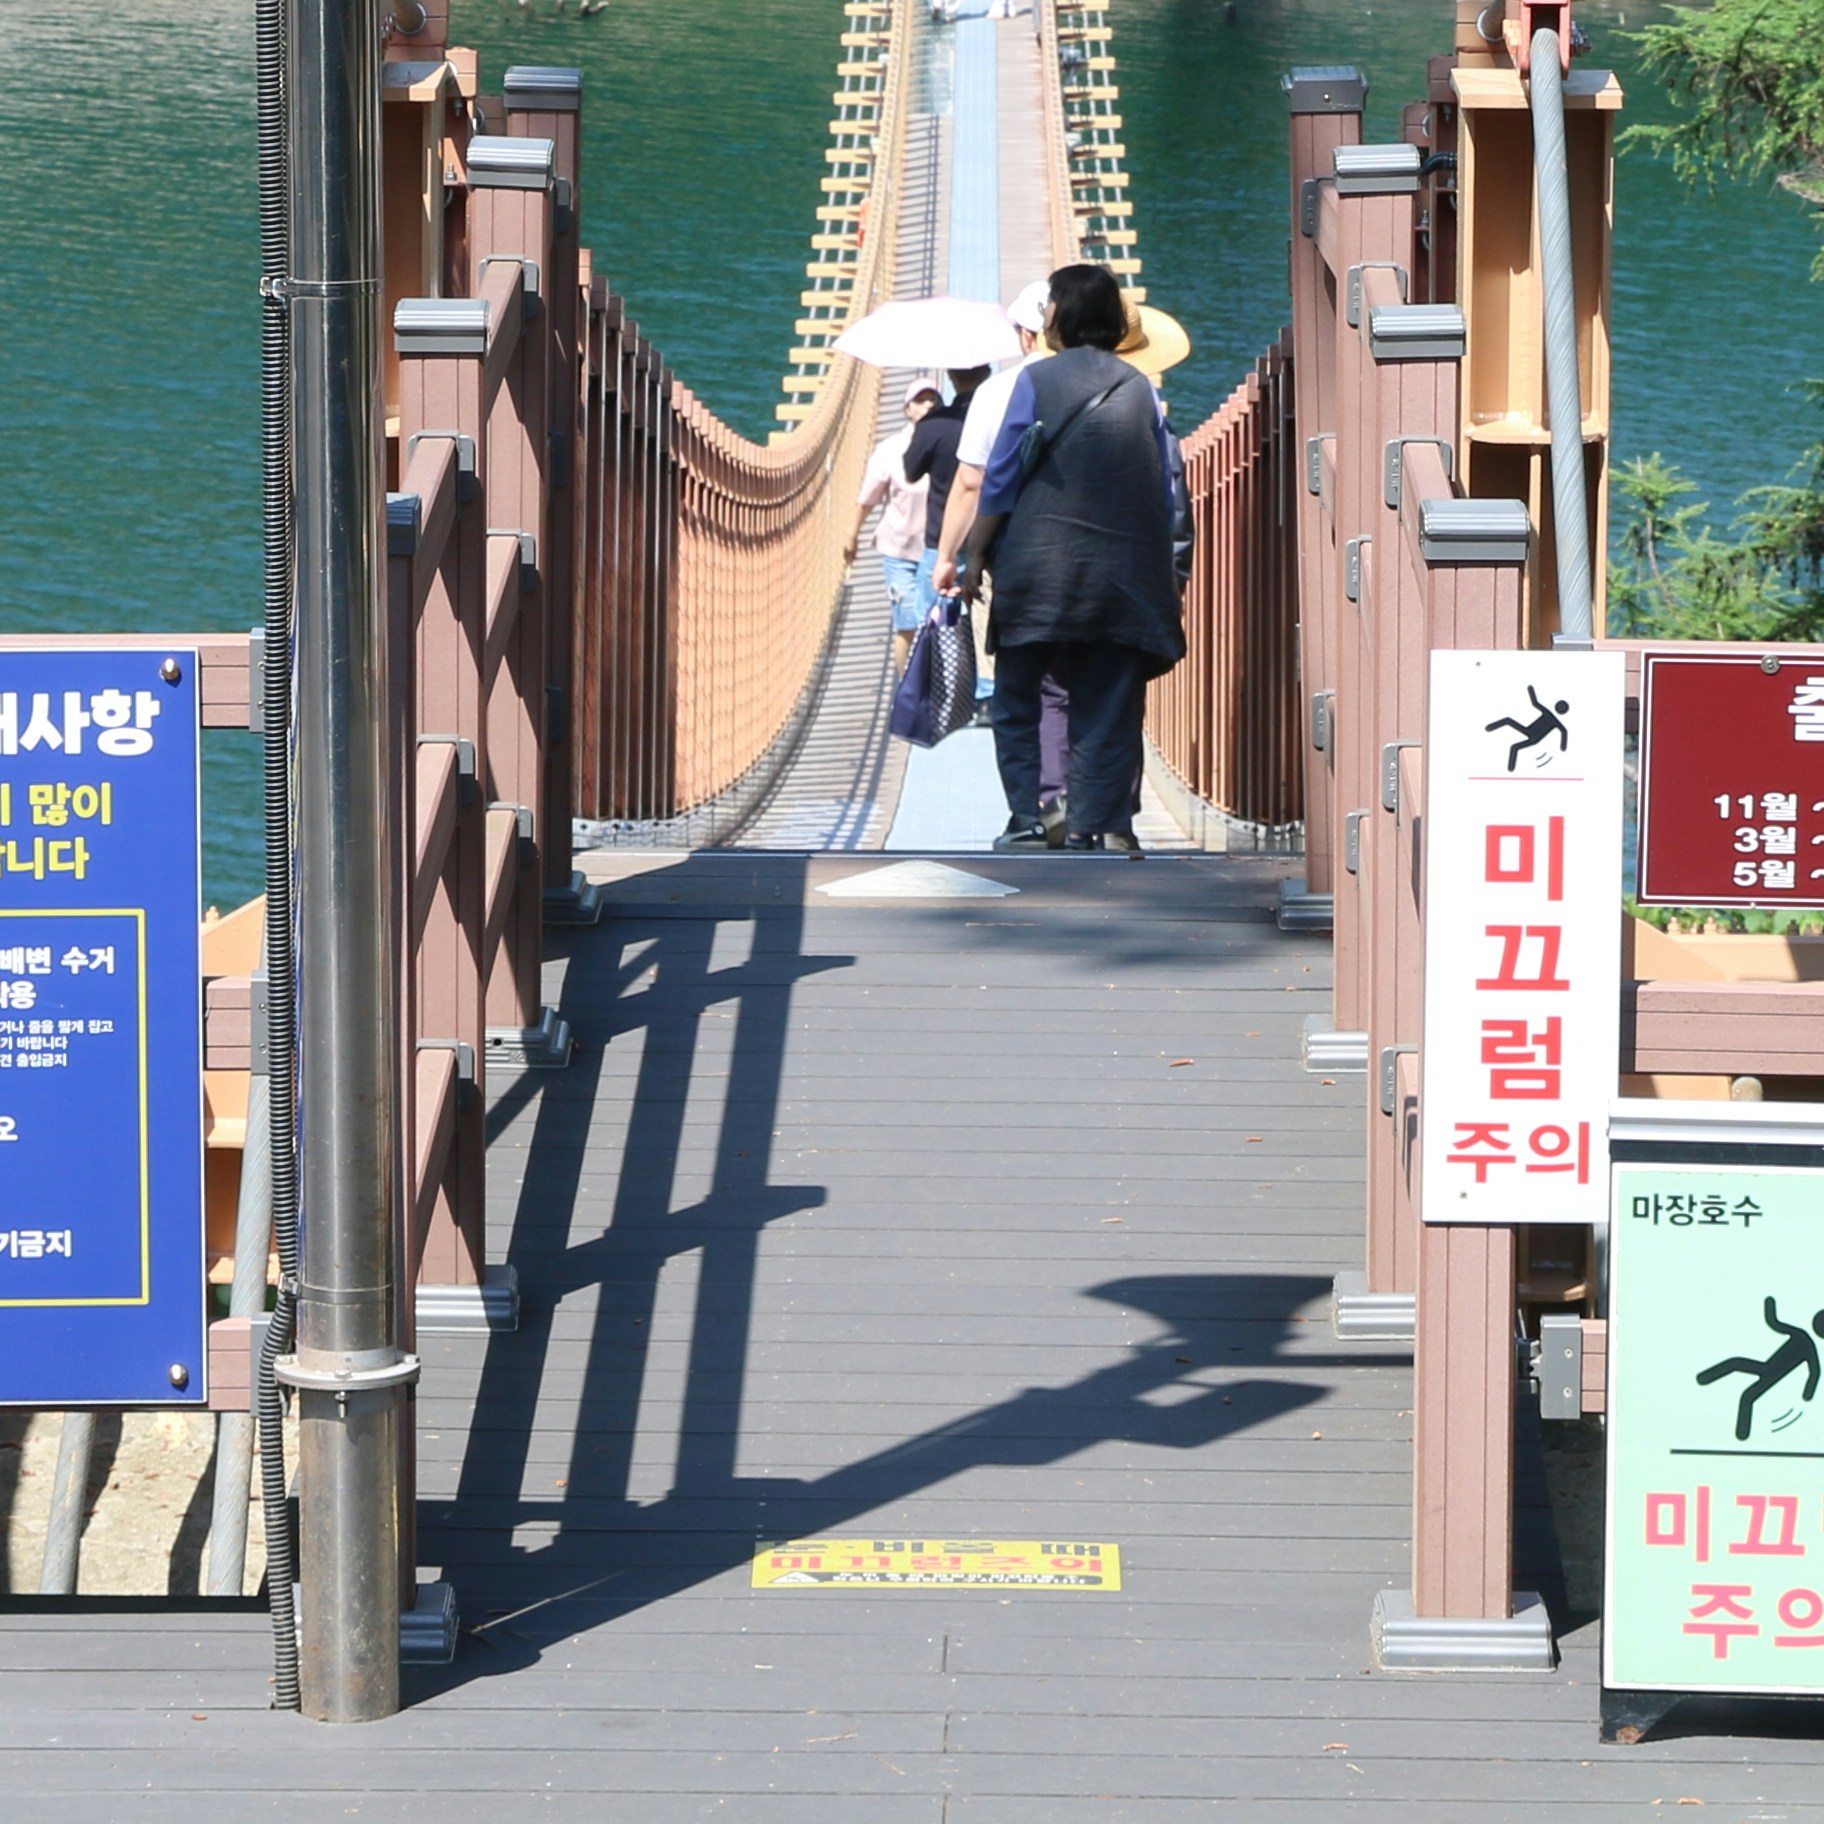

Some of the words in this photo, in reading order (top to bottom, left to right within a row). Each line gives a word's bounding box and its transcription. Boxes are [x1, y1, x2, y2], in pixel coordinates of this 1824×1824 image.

[29, 782, 111, 826] 많이
[1715, 793, 1797, 821] 11월
[1734, 826, 1796, 854] 3월
[1734, 860, 1795, 888] 5월
[0, 947, 51, 974] 배변
[61, 946, 114, 974] 수거
[1476, 816, 1570, 1100] 미끄럼
[28, 1020, 54, 1034] 줄을
[58, 1020, 83, 1033] 짧게
[89, 1020, 113, 1033] 잡고
[17, 1036, 67, 1050] 바랍니다
[16, 1053, 66, 1067] 출입금지
[1447, 1122, 1590, 1184] 주의
[1634, 1195, 1761, 1226] 마장호수
